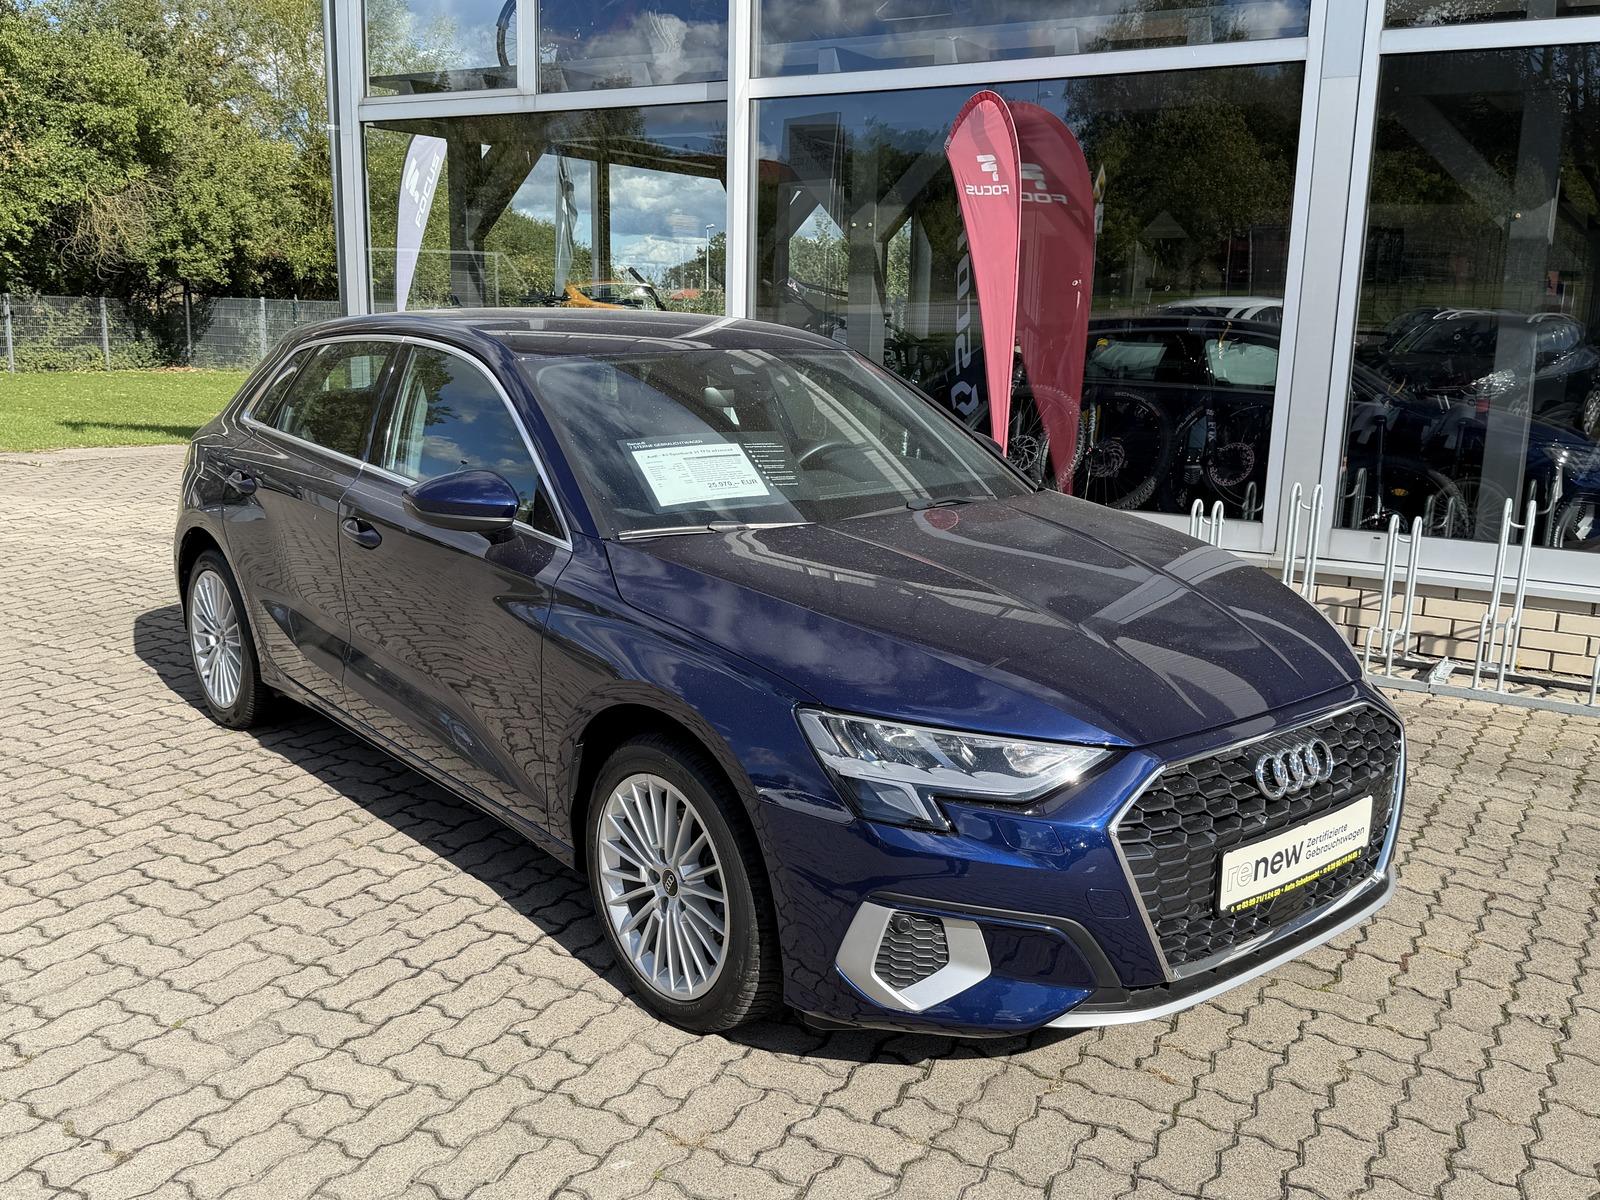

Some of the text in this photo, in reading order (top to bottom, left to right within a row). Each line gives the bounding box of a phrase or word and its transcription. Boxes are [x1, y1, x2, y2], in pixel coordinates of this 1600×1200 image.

[415, 151, 440, 228] FOCUS
[741, 478, 758, 486] EUR
[1305, 827, 1365, 860] Gebrauchtwagen
[1306, 823, 1348, 848] Zertifizierte
[1226, 840, 1304, 892] renew
